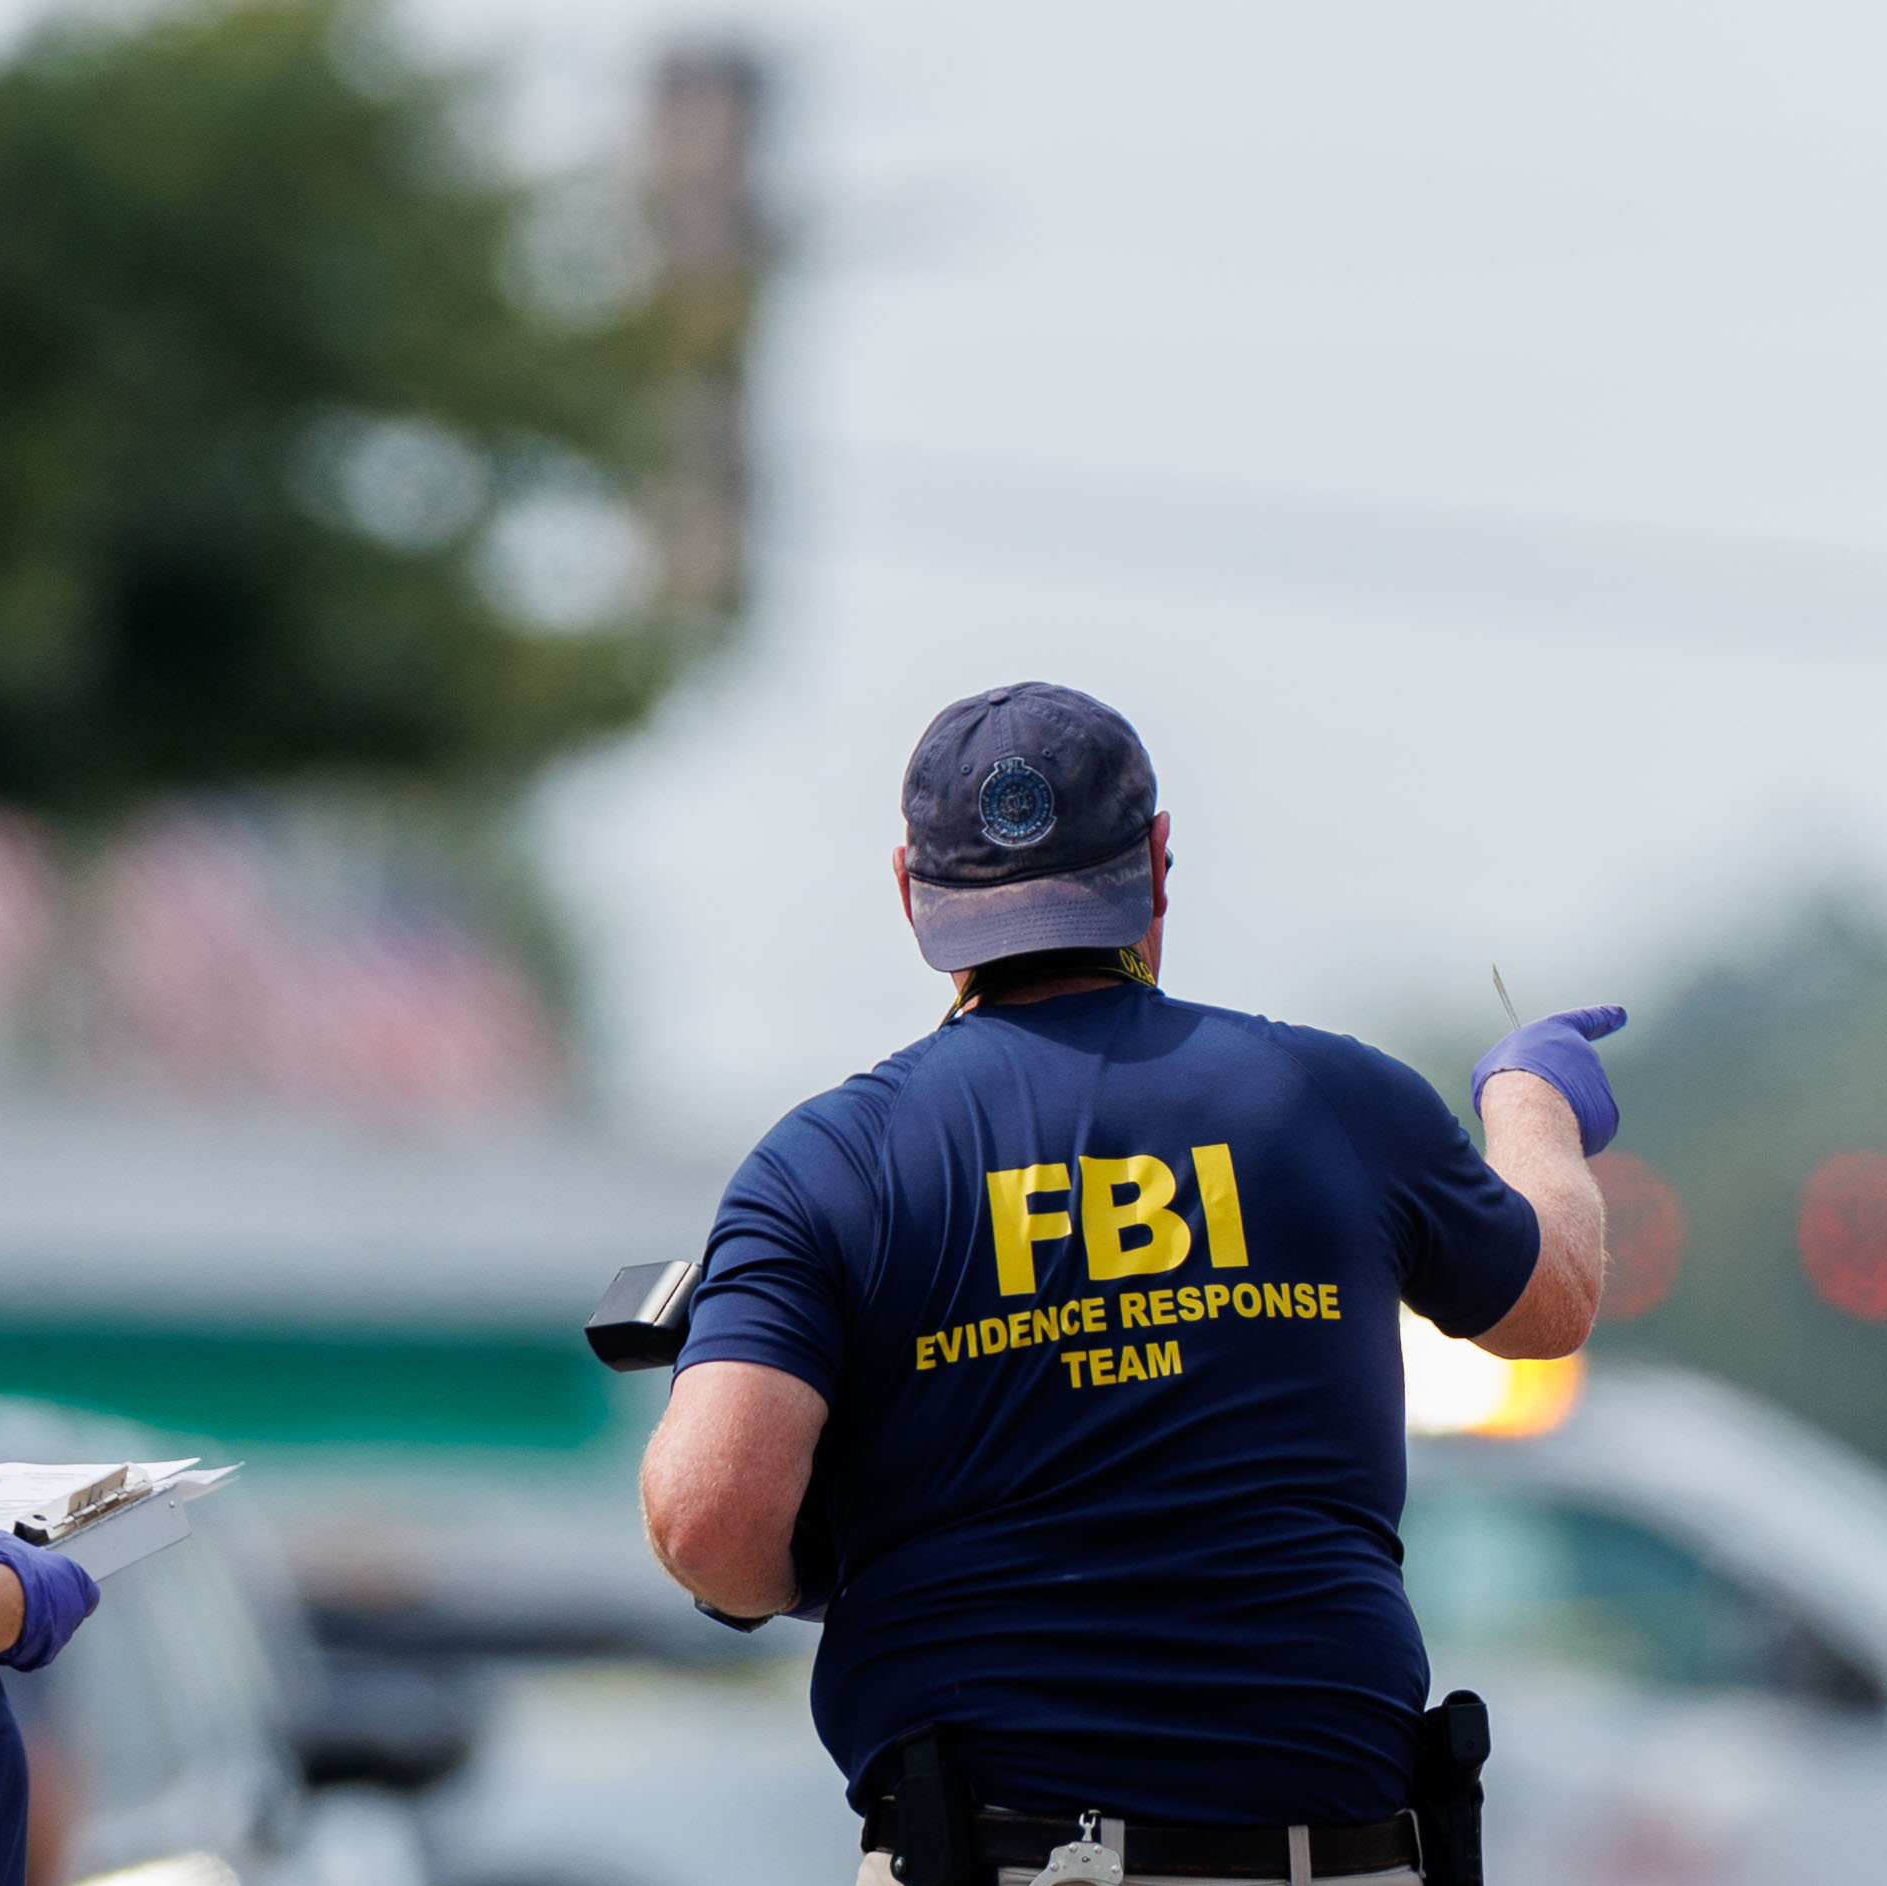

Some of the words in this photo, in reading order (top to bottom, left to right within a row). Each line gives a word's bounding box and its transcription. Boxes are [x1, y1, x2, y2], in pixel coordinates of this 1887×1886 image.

[986, 1143, 1249, 1296] FBI
[916, 1297, 1108, 1371] EVIDENCE
[1120, 1282, 1341, 1329] RESPONSE
[1060, 1340, 1183, 1388] TEAM
